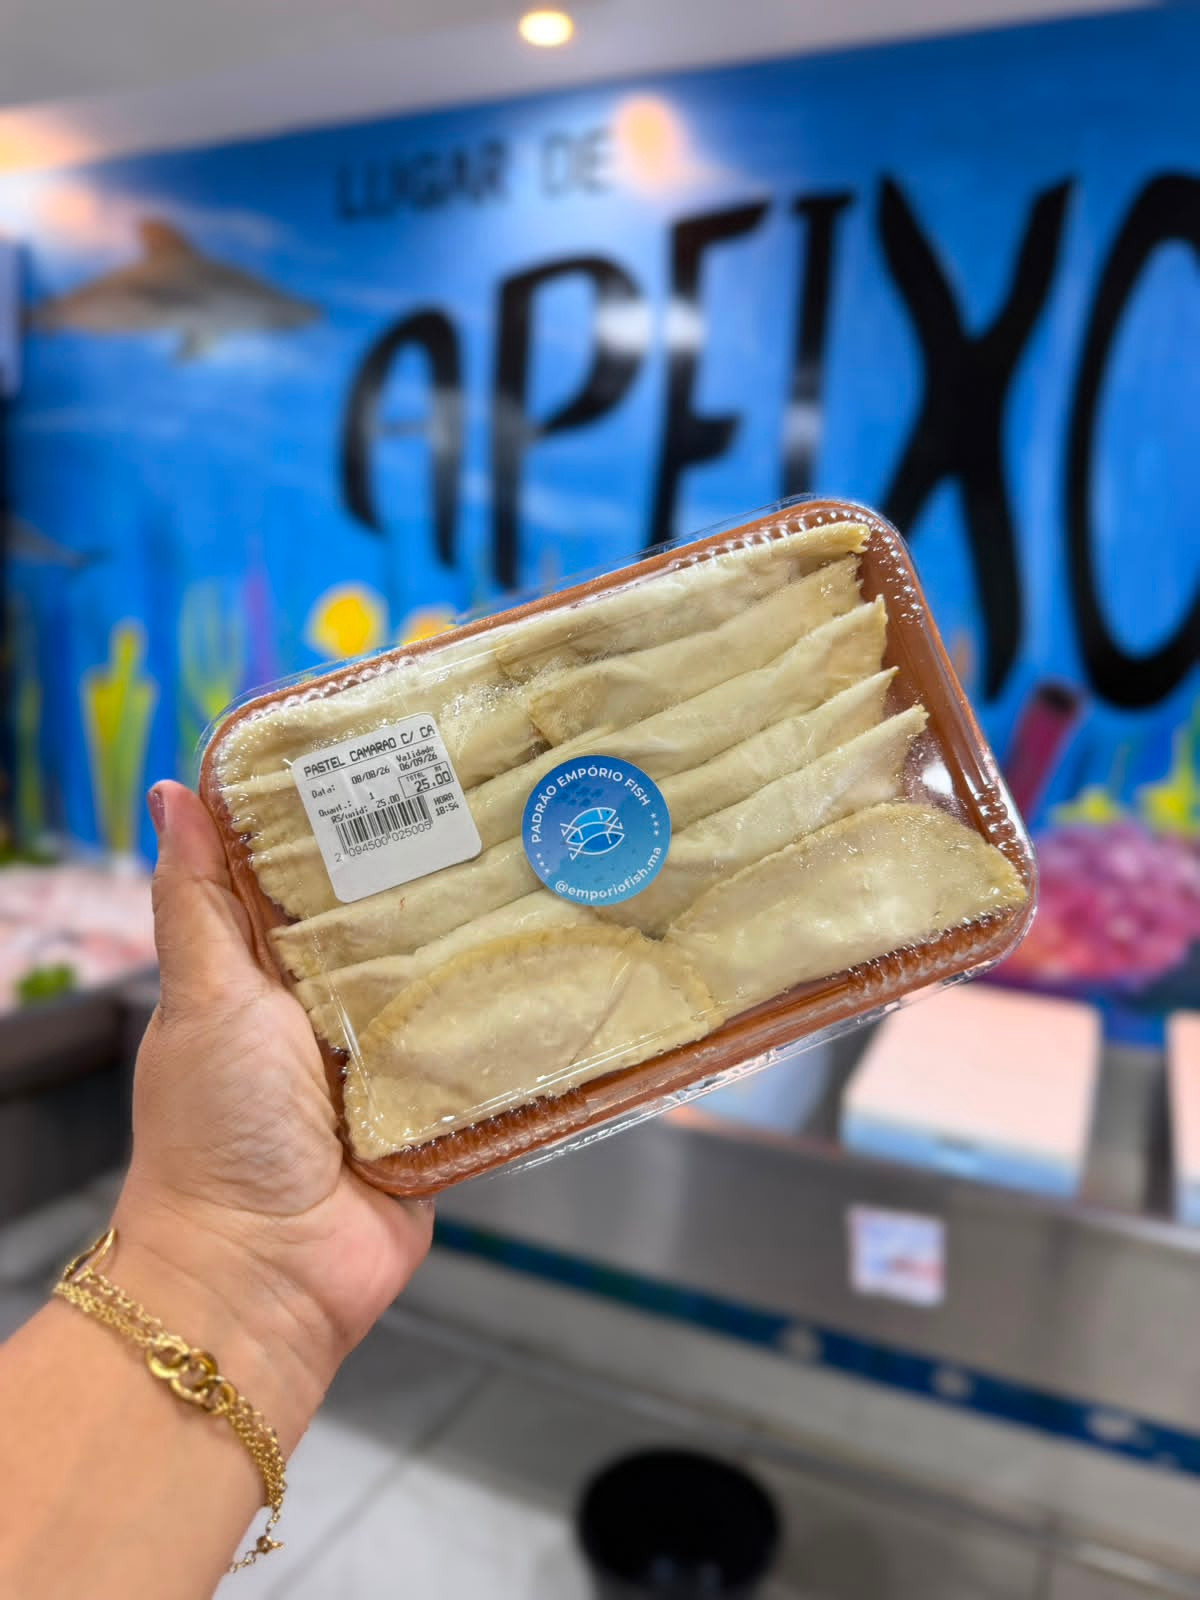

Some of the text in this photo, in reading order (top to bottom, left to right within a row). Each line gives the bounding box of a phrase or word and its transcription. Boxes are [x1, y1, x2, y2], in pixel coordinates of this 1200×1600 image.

[335, 140, 509, 222] LUGAR
[303, 724, 436, 777] PASTEL CAMARAO C/ CA
[406, 772, 425, 782] TOTAL
[414, 771, 451, 793] 25.00
[311, 784, 336, 799] Data:
[369, 792, 375, 800] 1
[376, 794, 401, 809] 25.00
[433, 792, 454, 806] HORA
[531, 765, 651, 843] PADRÃO EMPÓRIO FISH
[334, 822, 432, 863] 2 094500 025005
[555, 846, 662, 901] @emporiofish.ma
